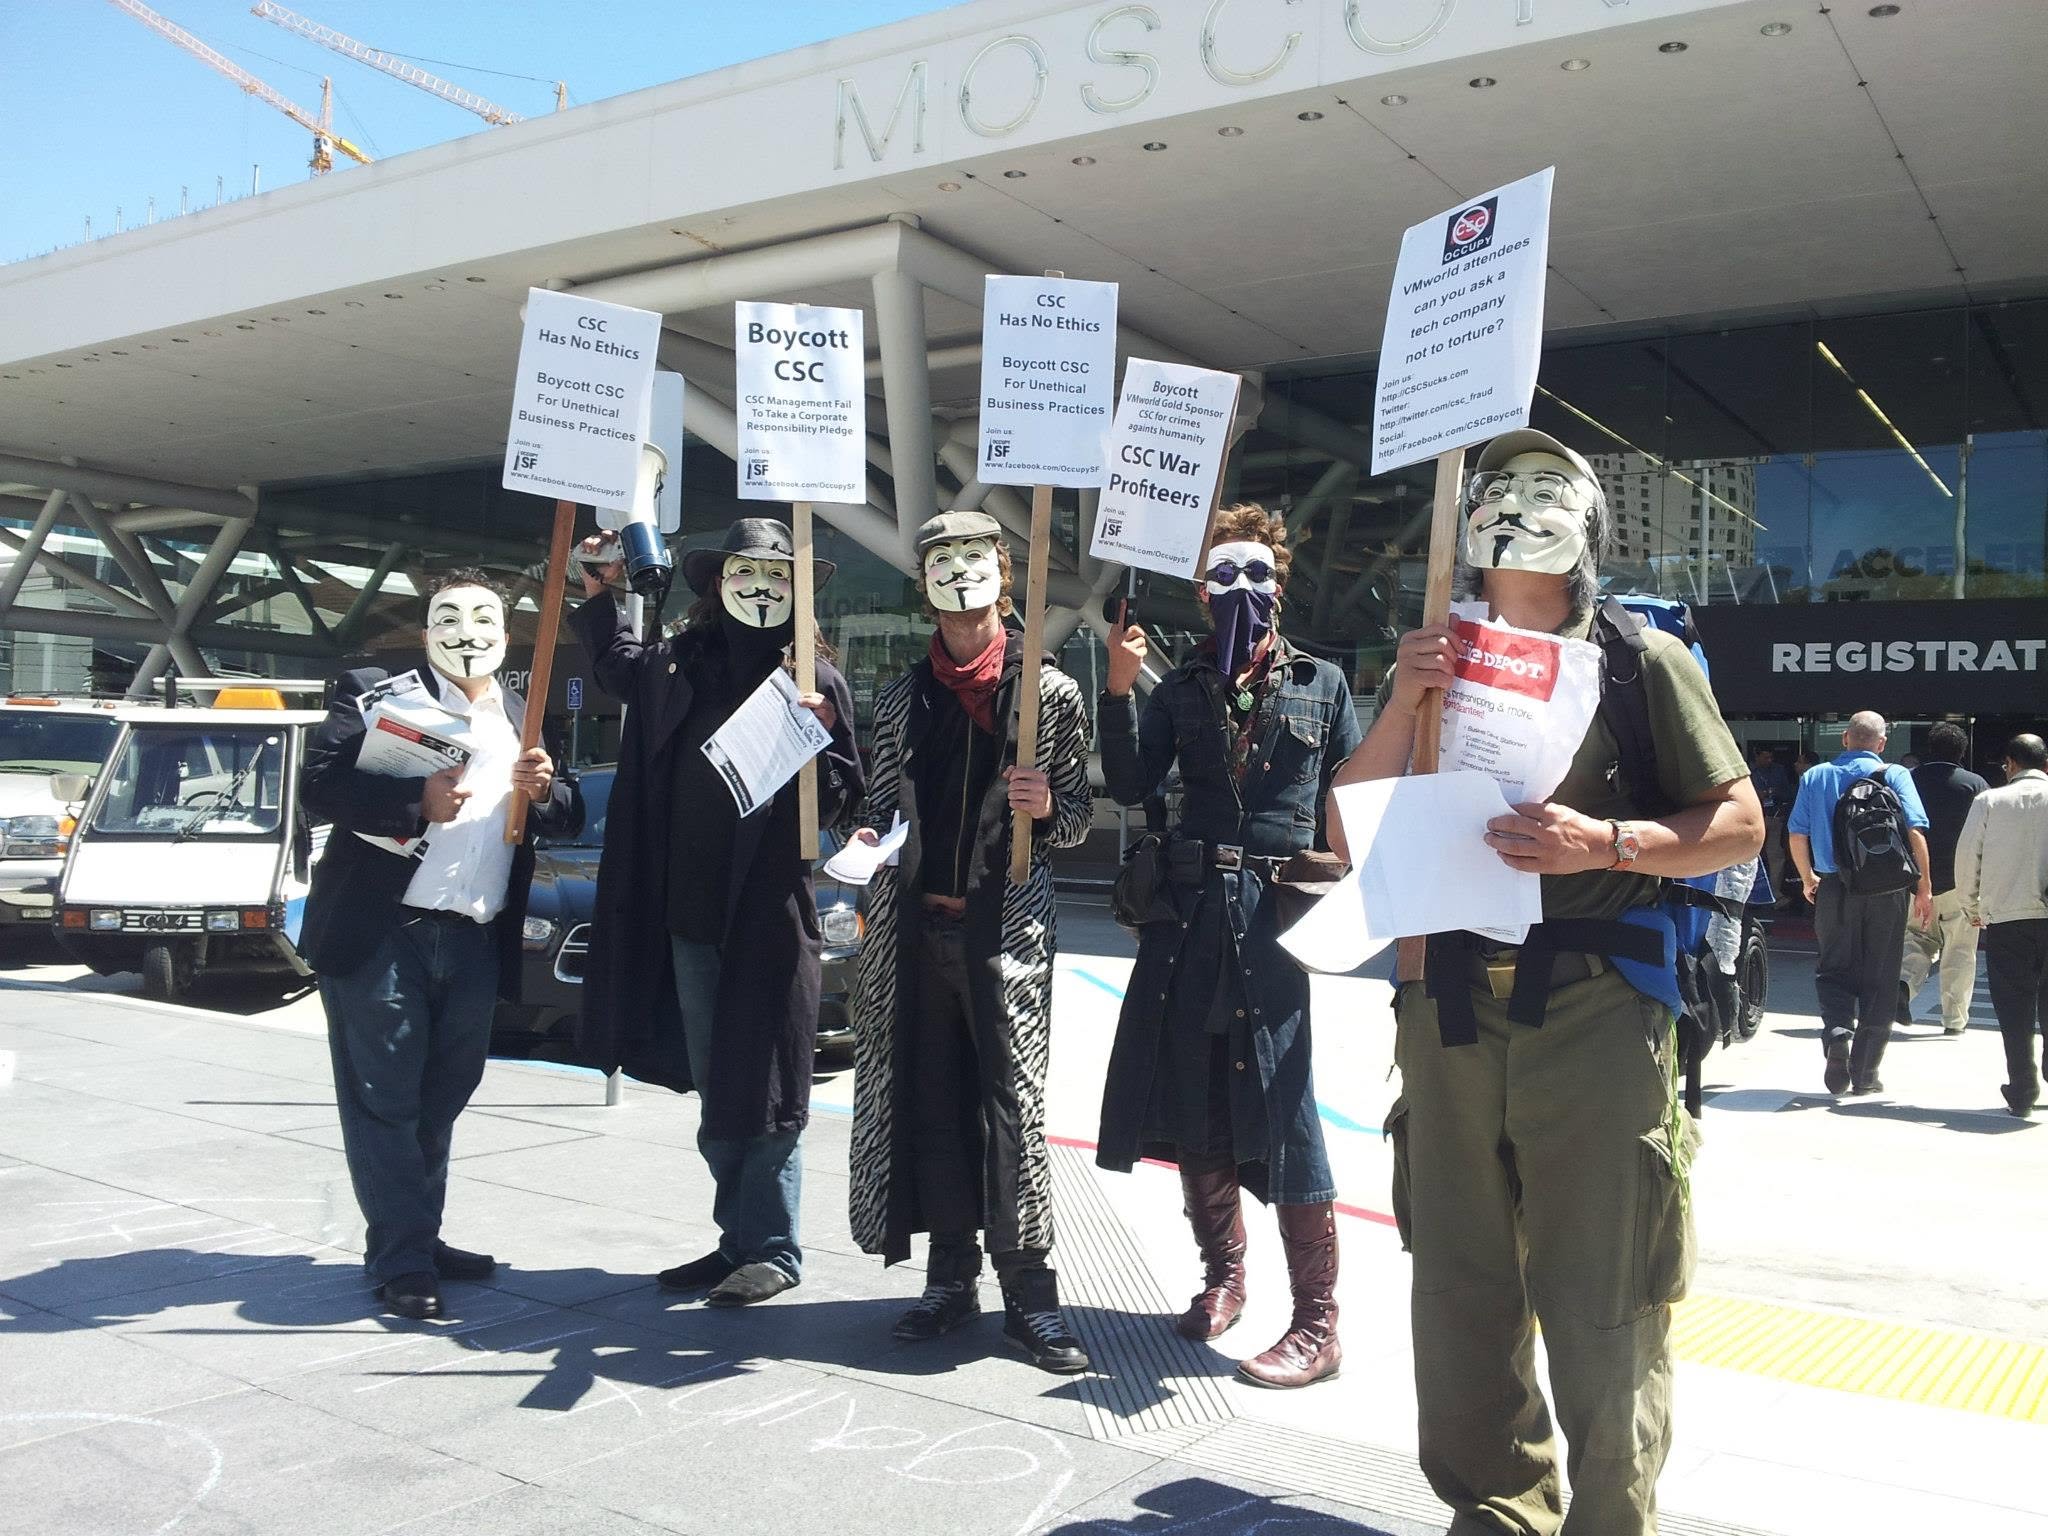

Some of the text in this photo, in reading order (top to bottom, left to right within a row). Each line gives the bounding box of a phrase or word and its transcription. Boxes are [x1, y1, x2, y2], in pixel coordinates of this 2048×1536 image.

[1456, 216, 1485, 236] CSC
[1444, 235, 1492, 262] OCCUPY
[1403, 238, 1530, 296] VMworld attendees
[1037, 294, 1066, 308] CSC
[1414, 271, 1506, 315] can you ask a
[578, 316, 608, 332] CSC
[1000, 313, 1100, 332] Has No Ethics
[1410, 294, 1506, 339] tech company
[539, 329, 640, 360] Has No Ethics
[749, 322, 848, 351] Boycott
[1405, 319, 1504, 364] not to torture?
[775, 360, 824, 382] CSC
[1003, 357, 1090, 374] Boycott CSC
[537, 372, 625, 399] Boycott CSC
[1004, 378, 1086, 394] For Unethical
[1153, 381, 1199, 399] Boycott
[1381, 368, 1469, 403] http://CSCSucks.com
[1382, 379, 1400, 390] Join
[537, 394, 619, 418] For Unethical
[745, 395, 852, 408] CSC Management Fail
[987, 398, 1105, 415] Business Practices
[1126, 393, 1224, 418] VMworld Gold Sponsor
[1379, 386, 1493, 431] http://twitter.com/csc_fraud
[1381, 402, 1410, 417] Twitter:
[752, 409, 763, 418] To
[766, 410, 788, 419] Take
[799, 412, 848, 422] Corporate
[1139, 409, 1200, 429] CSC for crimes
[519, 410, 636, 442] Business Practices
[747, 422, 853, 436] Responsibility Pledge
[1159, 427, 1205, 445] humanity
[1378, 406, 1524, 459] http://Facebook.com/CSCBoycott
[515, 439, 530, 448] Join
[994, 445, 1010, 457] SF
[521, 457, 538, 469] SF
[753, 464, 769, 476] SF
[984, 462, 1100, 474] www.facebook.com/OccupySF
[1121, 445, 1201, 476] CSC War
[510, 471, 626, 497] www.facebook.com/OccupySF
[745, 480, 856, 491] www.facebook.com/OccupySF
[1109, 473, 1200, 509] Profiteers
[1107, 524, 1122, 536] SF
[1772, 639, 2046, 673] REGISTRAT
